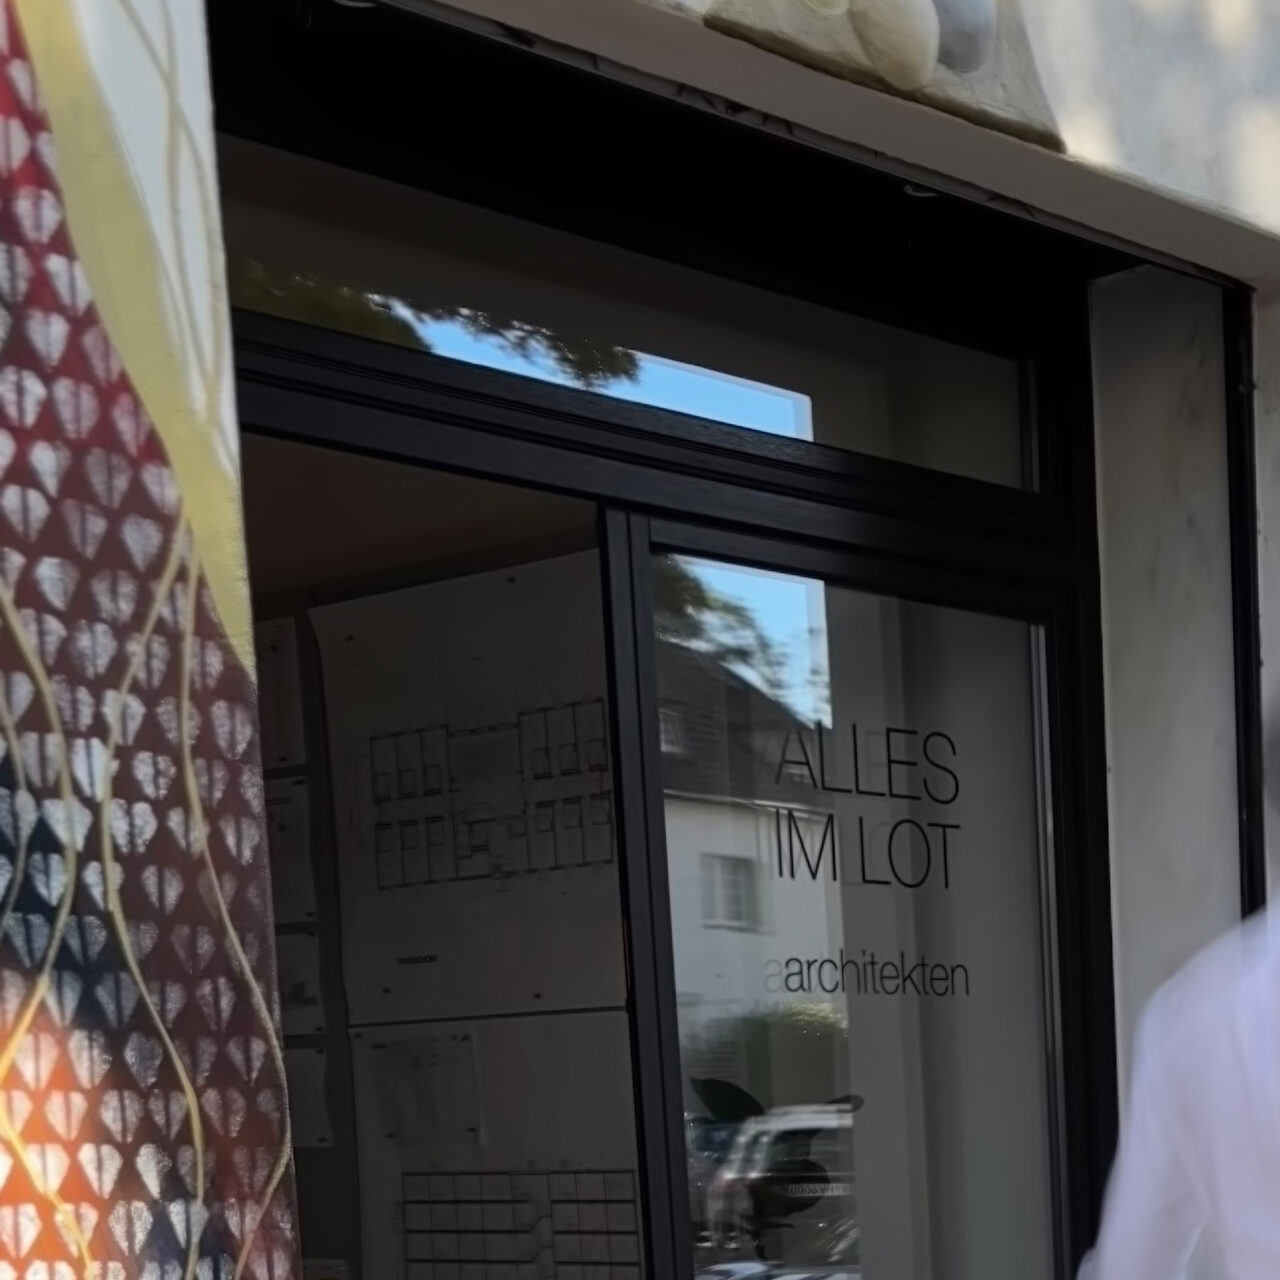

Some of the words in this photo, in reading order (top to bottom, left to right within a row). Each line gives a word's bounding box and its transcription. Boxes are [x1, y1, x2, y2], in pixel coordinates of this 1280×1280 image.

[775, 720, 959, 805] ALLES
[776, 808, 838, 882] IM
[858, 816, 961, 890] LOT
